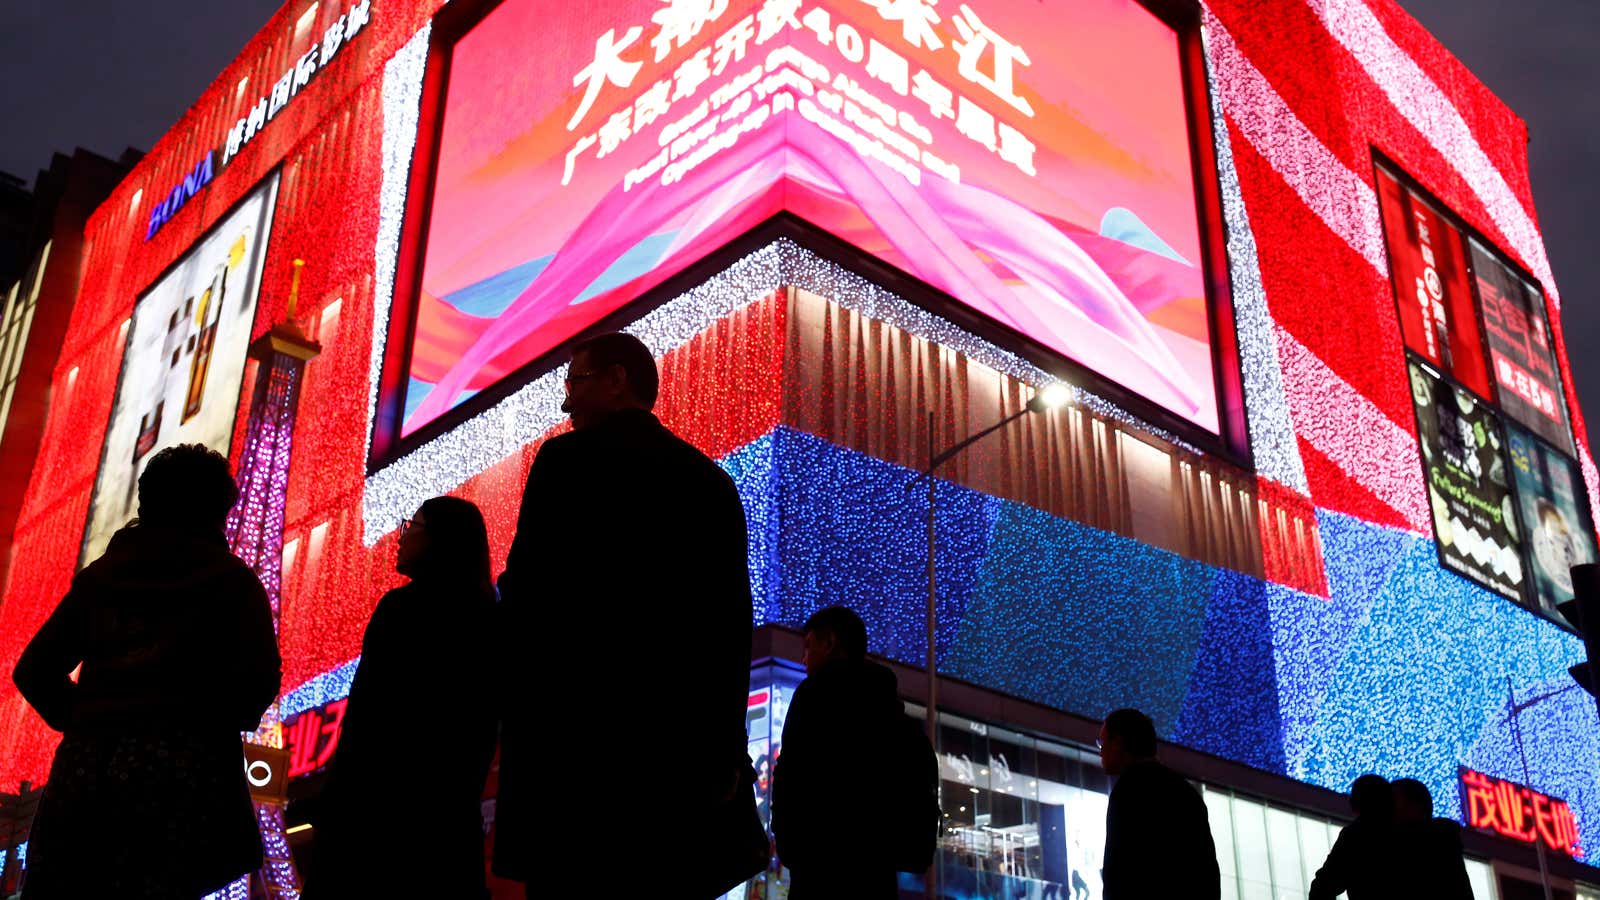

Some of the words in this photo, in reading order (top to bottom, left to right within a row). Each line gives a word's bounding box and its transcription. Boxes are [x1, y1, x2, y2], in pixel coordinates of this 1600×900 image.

[145, 150, 213, 241] BONA
[222, 0, 371, 165] 博纳国际影城
[1462, 769, 1583, 858] 茂业天地
